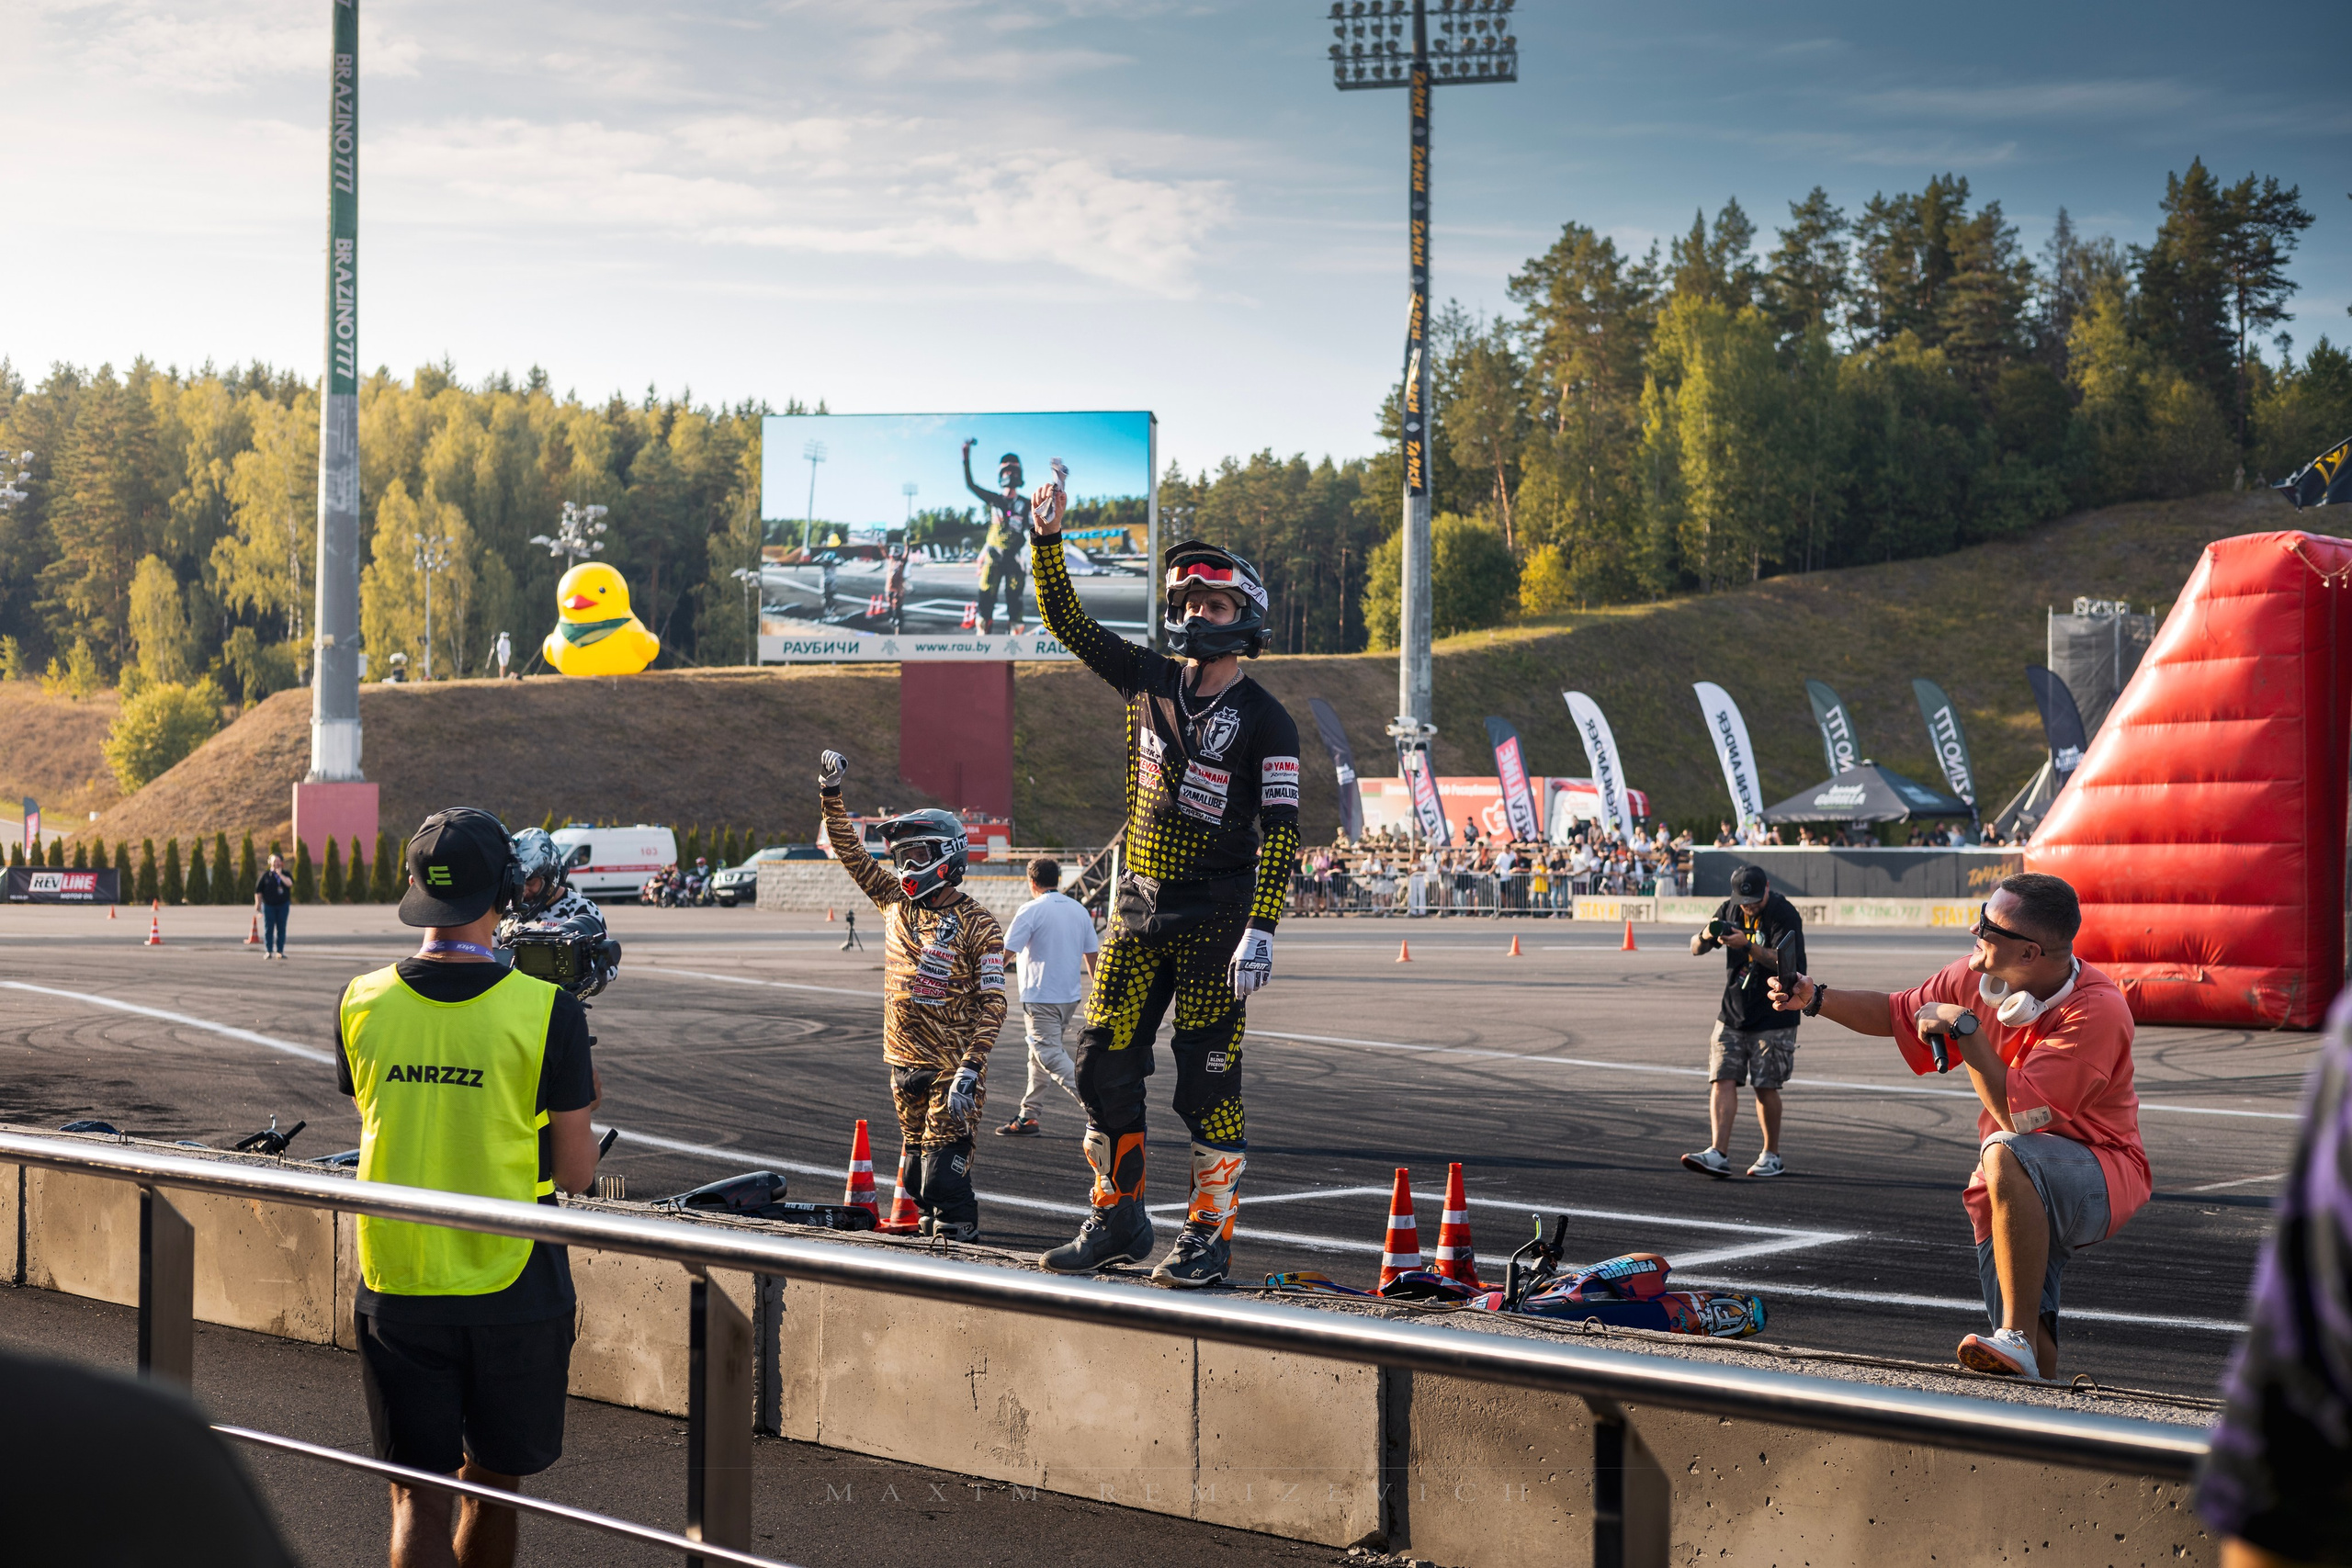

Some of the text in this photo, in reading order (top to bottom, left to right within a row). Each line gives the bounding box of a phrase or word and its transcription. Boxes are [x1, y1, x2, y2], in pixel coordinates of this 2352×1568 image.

[335, 53, 354, 194] BRAZINO777
[335, 238, 355, 380] BRAZINO777
[783, 641, 860, 655] РАУБИЧИ
[915, 640, 991, 656] www.rau.by
[1183, 788, 1226, 809] YAMALUBE
[928, 947, 954, 962] YAMAHA
[576, 977, 599, 1001] RONIN
[915, 976, 948, 989] KENDA
[913, 986, 946, 998] SENA
[386, 1065, 484, 1089] ANRZZZ
